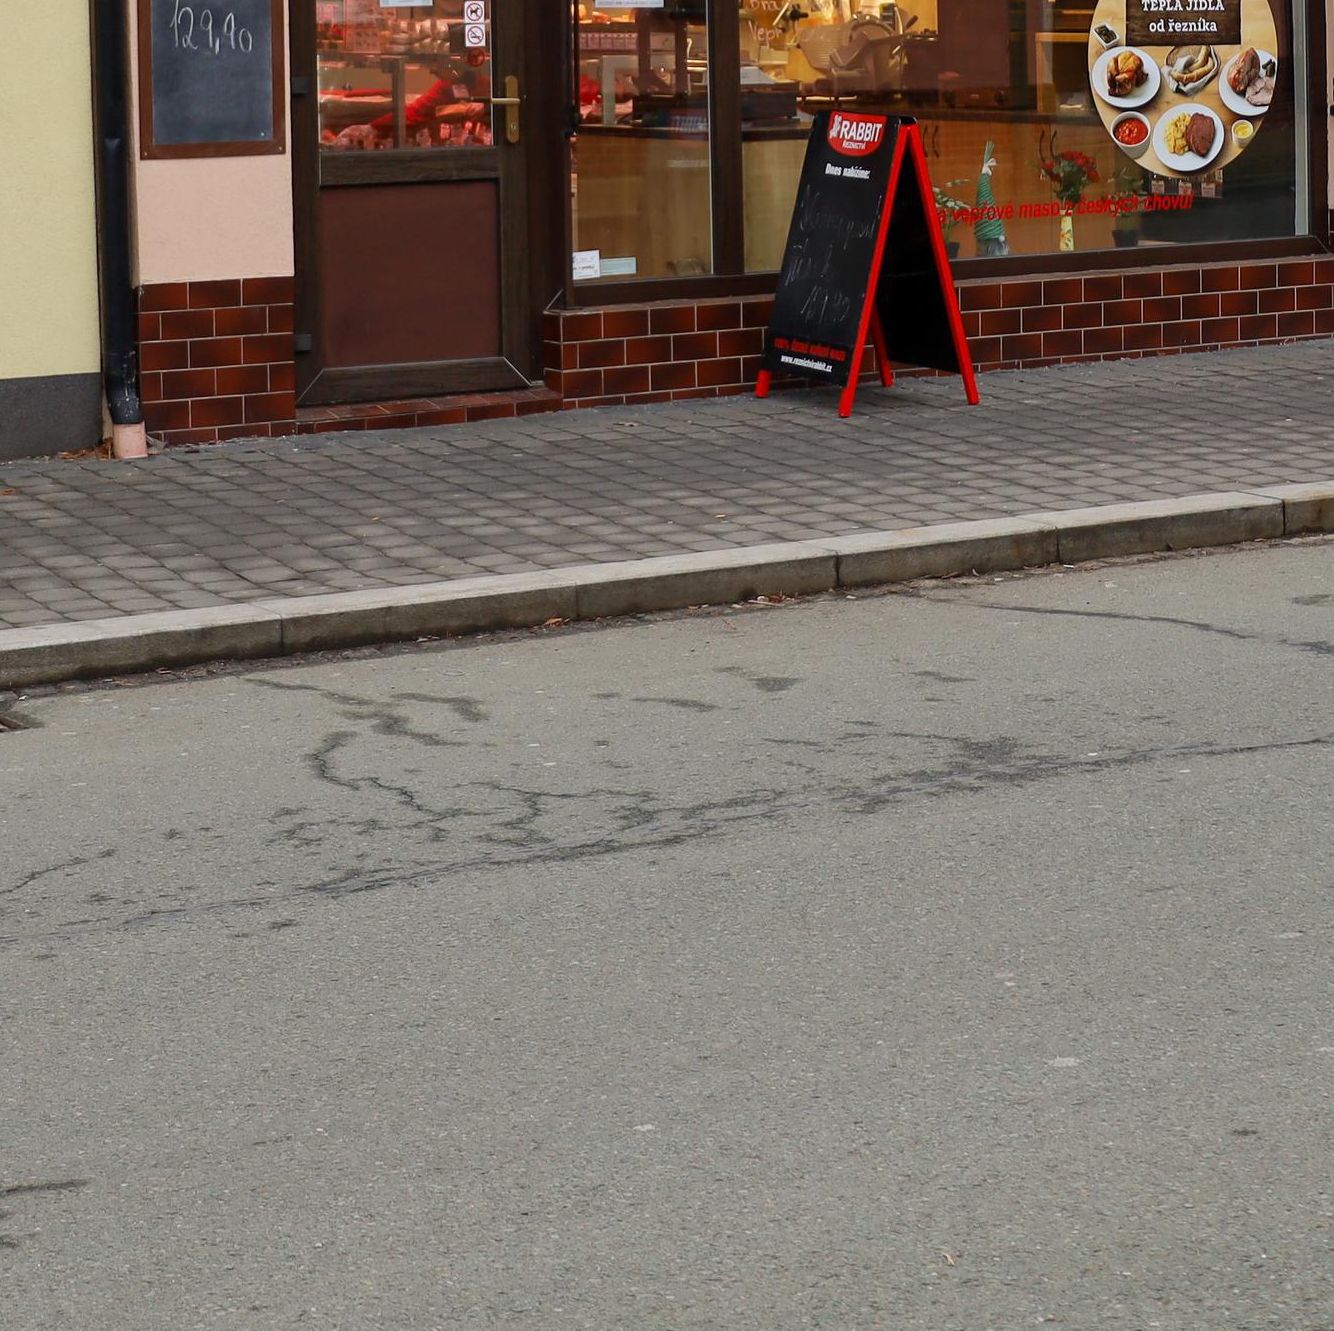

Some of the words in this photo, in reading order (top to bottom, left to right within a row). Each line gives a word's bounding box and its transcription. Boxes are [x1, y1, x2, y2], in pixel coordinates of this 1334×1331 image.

[1149, 18, 1165, 33] od
[1167, 18, 1218, 33] řezníka
[839, 120, 883, 143] RABBIT
[825, 162, 842, 176] Dnes
[1018, 203, 1060, 218] maso
